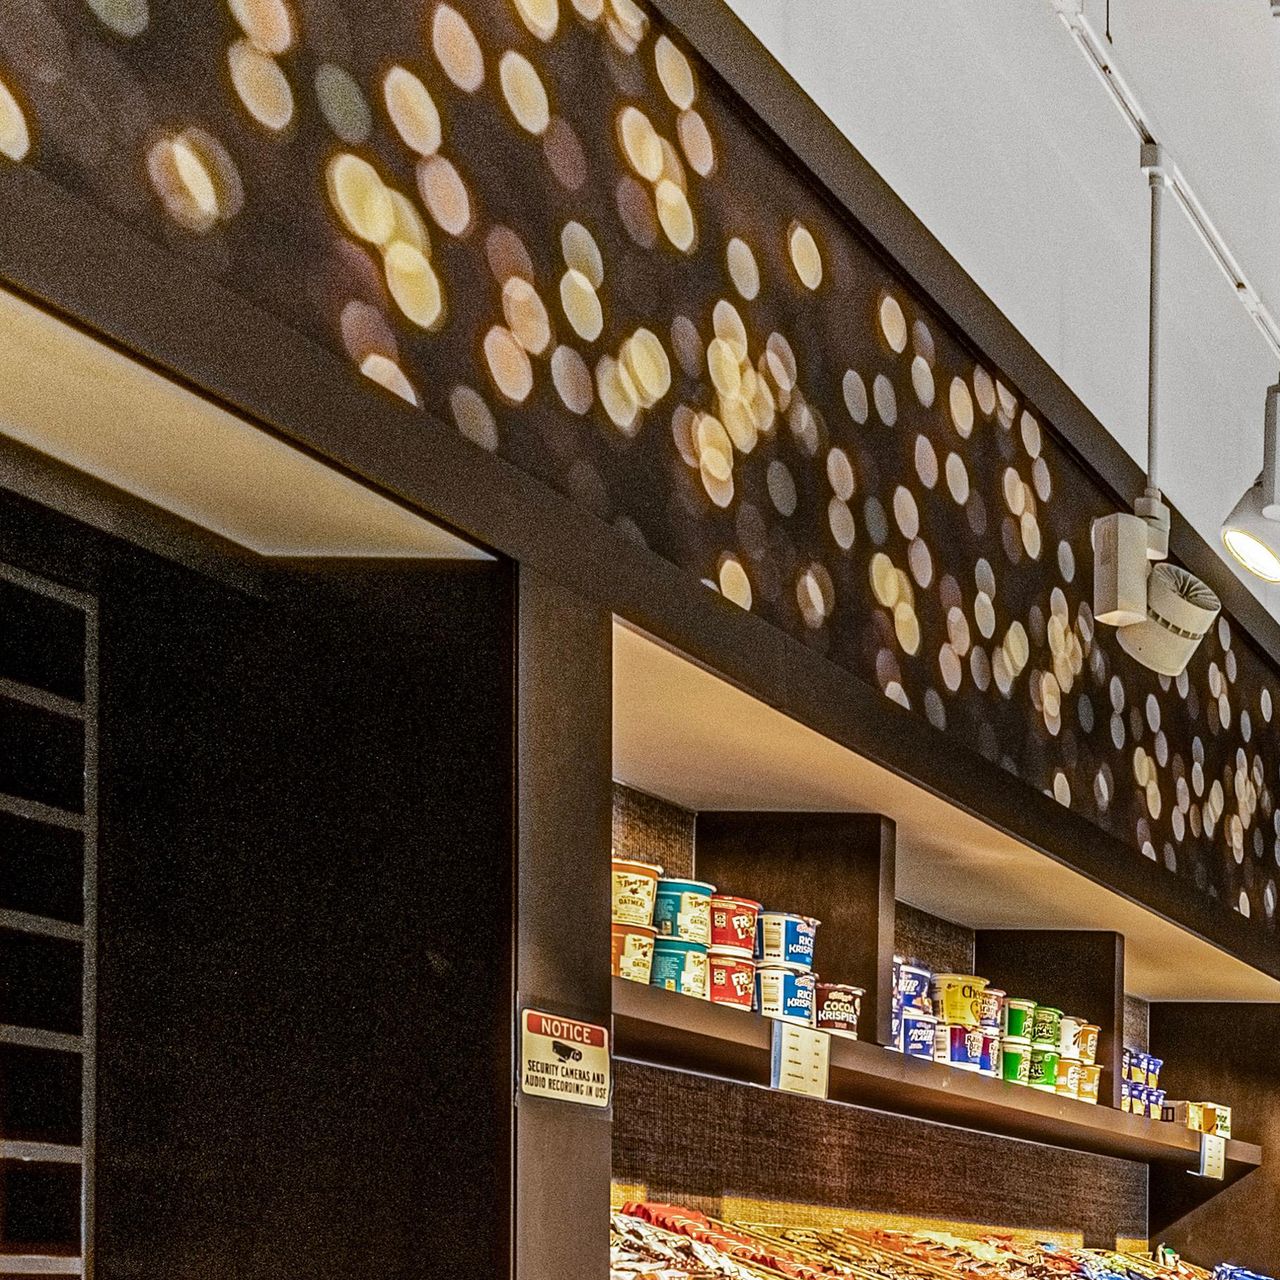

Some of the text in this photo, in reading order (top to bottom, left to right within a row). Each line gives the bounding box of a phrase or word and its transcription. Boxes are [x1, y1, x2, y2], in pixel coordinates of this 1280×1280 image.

[818, 1010, 857, 1024] KRISPIES
[823, 1001, 854, 1013] COCOA
[541, 1018, 591, 1044] NOTICE
[527, 1060, 604, 1085] SECURITY CAMERAS AND
[525, 1074, 607, 1099] AUDIO RECORDING IN USE
